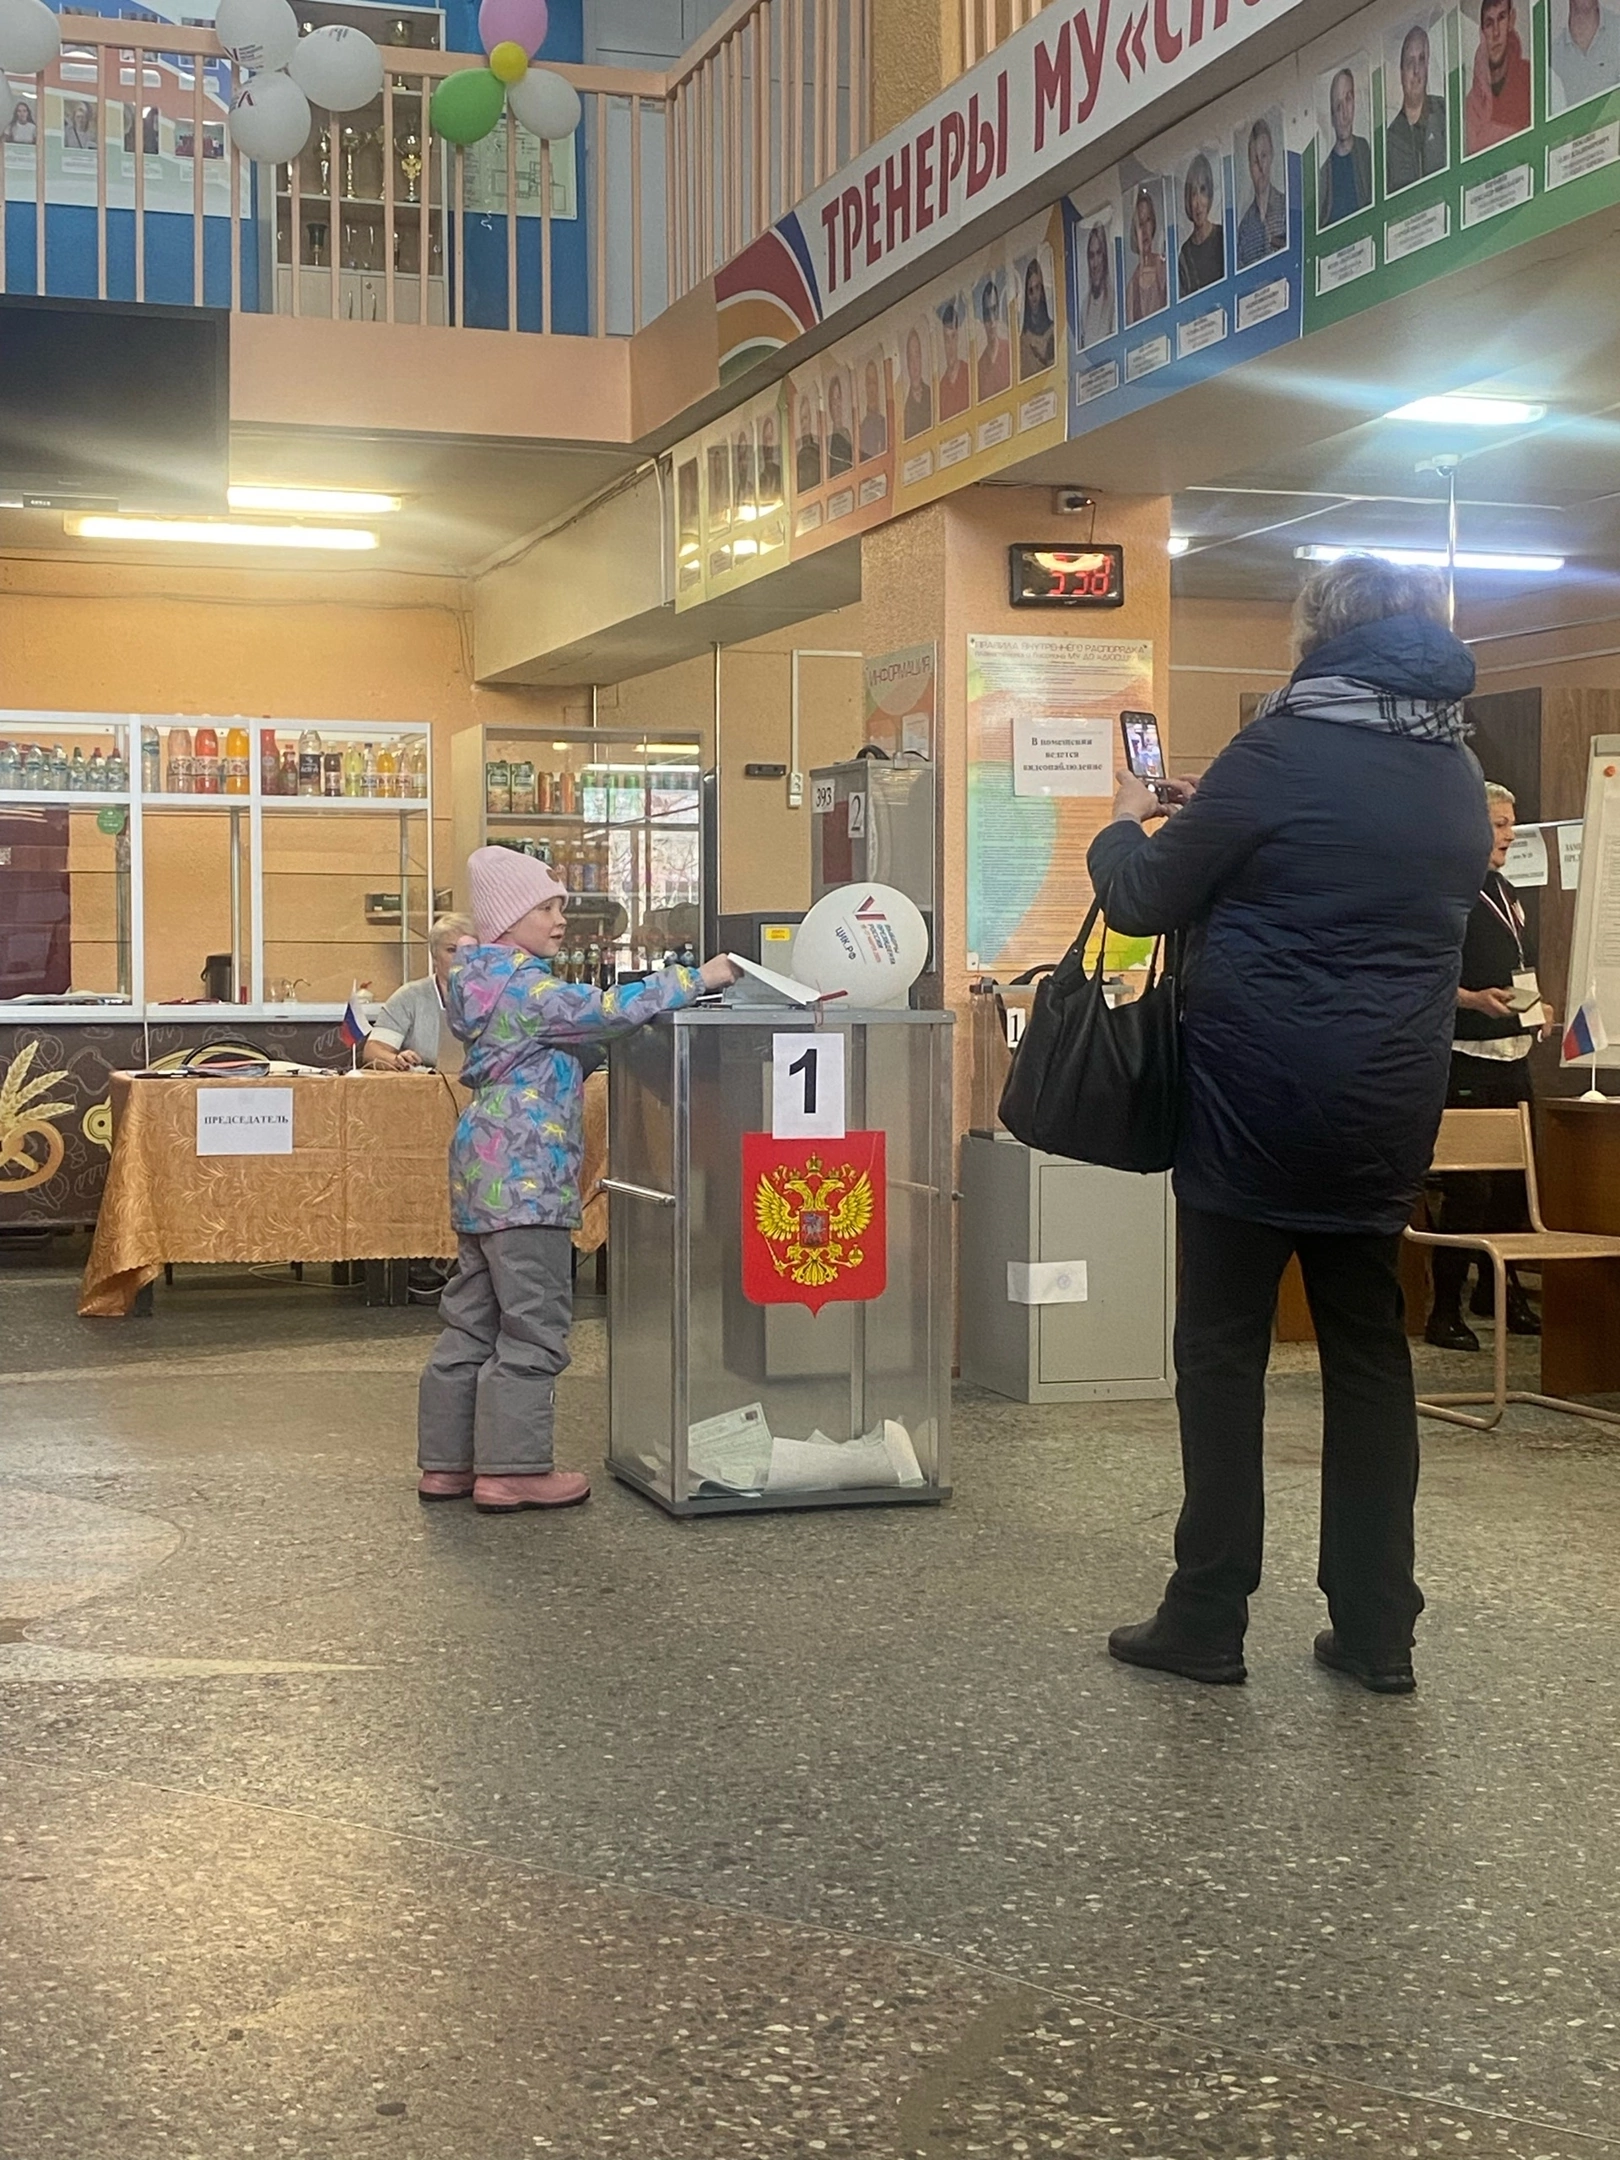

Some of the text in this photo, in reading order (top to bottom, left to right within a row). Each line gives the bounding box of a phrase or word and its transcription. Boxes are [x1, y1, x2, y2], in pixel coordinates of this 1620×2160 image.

[821, 70, 1009, 293] ТРЕНЕРЫ
[869, 656, 930, 687] ИНФОРМАЦИЯ
[1031, 737, 1038, 746] В
[1023, 762, 1102, 771] видеонаблюдение
[816, 787, 832, 807] 393
[852, 795, 861, 831] 2
[835, 926, 857, 960] ЦИК.РФ
[1010, 1014, 1018, 1042] 1
[789, 1048, 817, 1114] 1
[204, 1115, 289, 1124] ПРЕДСЕДАТЕЛЬ
